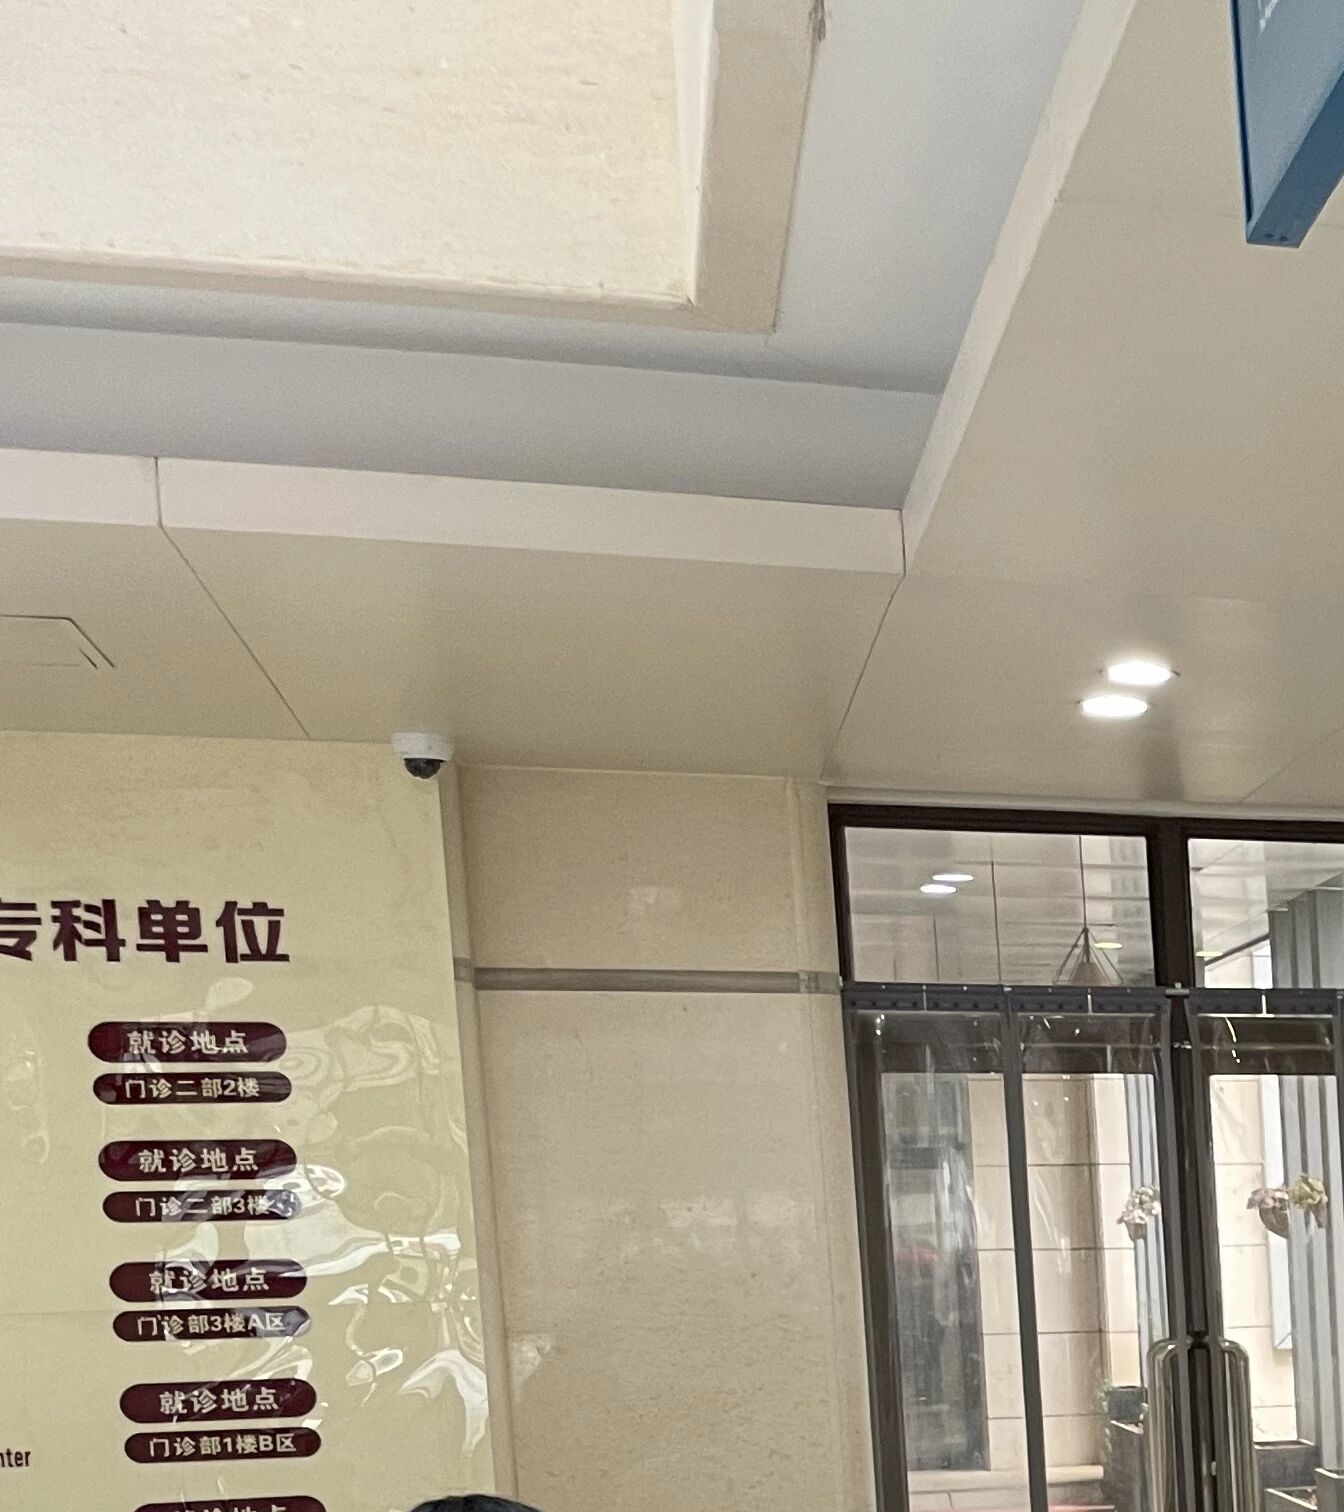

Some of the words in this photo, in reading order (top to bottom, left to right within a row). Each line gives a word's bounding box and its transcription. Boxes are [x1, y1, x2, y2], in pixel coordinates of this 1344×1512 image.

[0, 898, 290, 963] 专科单位
[127, 1030, 249, 1055] 就诊地点
[125, 1077, 260, 1099] 门诊二部2楼
[138, 1147, 259, 1173] 就诊地点
[135, 1195, 268, 1217] 门诊二部3楼
[149, 1267, 269, 1294] 就诊地点
[137, 1311, 286, 1335] 门诊部3楼A区
[160, 1386, 279, 1414] 就诊地点
[150, 1432, 297, 1458] 门诊部1楼B区
